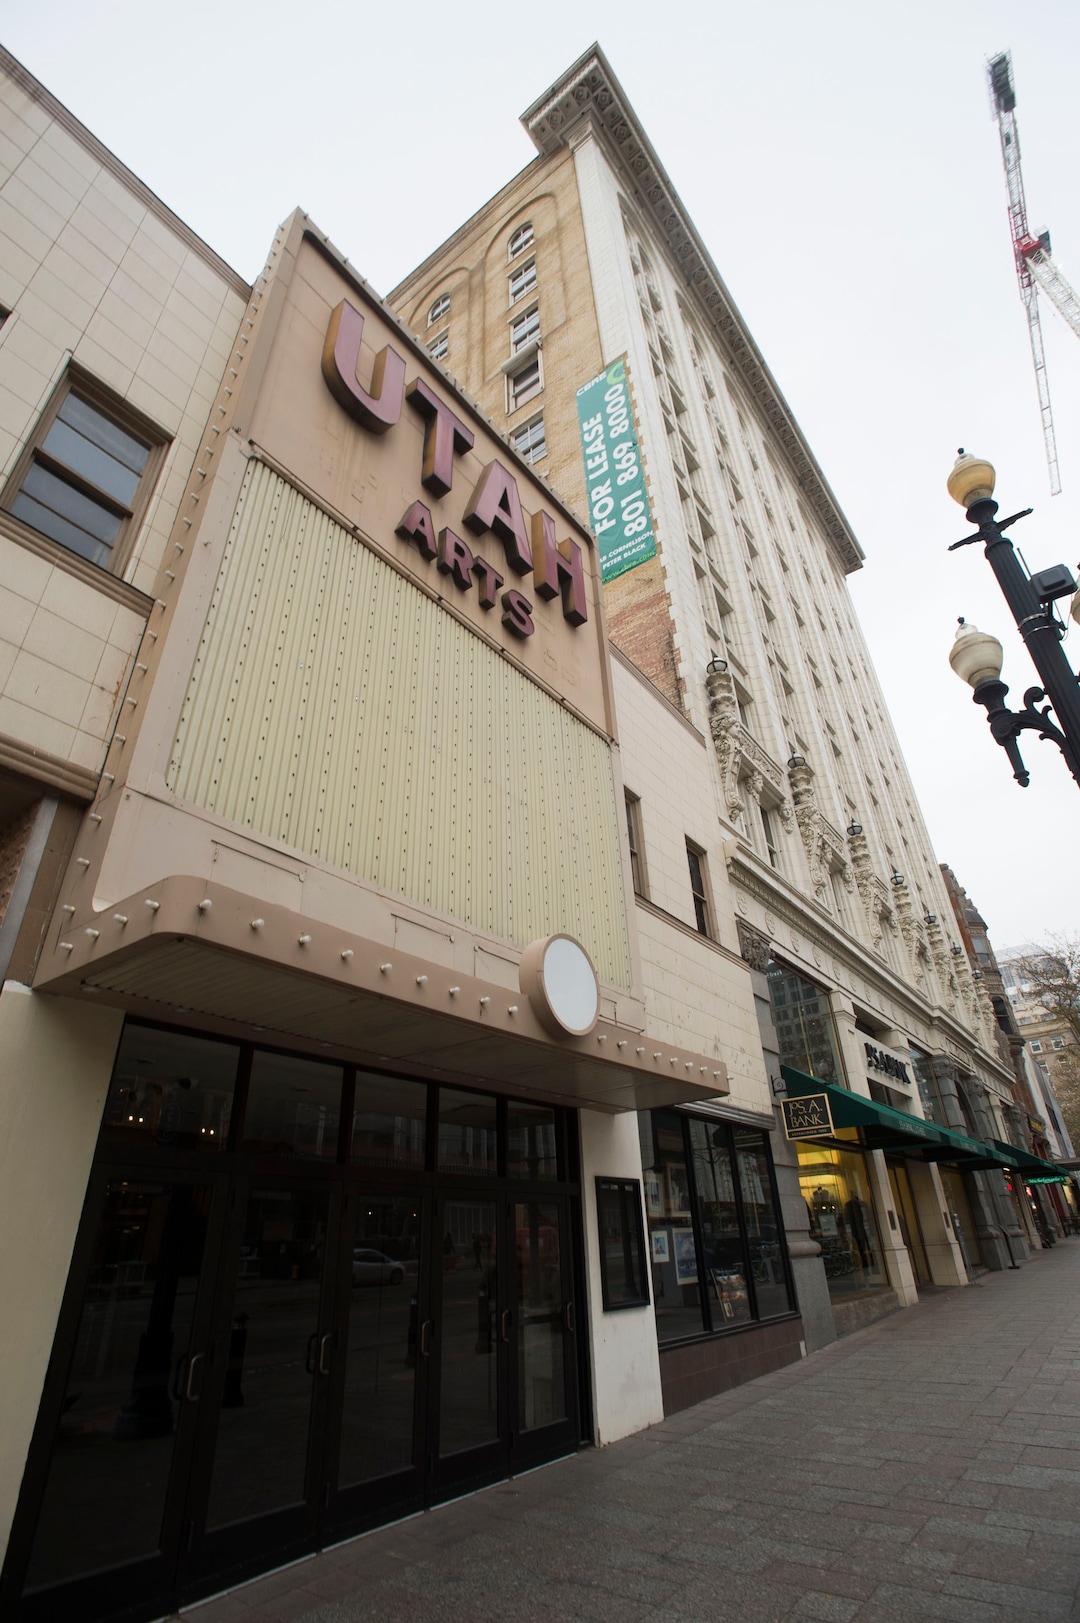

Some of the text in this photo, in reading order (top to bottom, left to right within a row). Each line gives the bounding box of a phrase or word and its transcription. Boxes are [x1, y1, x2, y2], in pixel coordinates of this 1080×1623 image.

[321, 298, 588, 628] UTAH
[582, 411, 616, 535] FOR LEASE
[604, 383, 648, 537] 801 869 8000
[394, 500, 535, 639] ARTS
[602, 543, 646, 570] PETER BLACK
[791, 1114, 824, 1128] BANK
